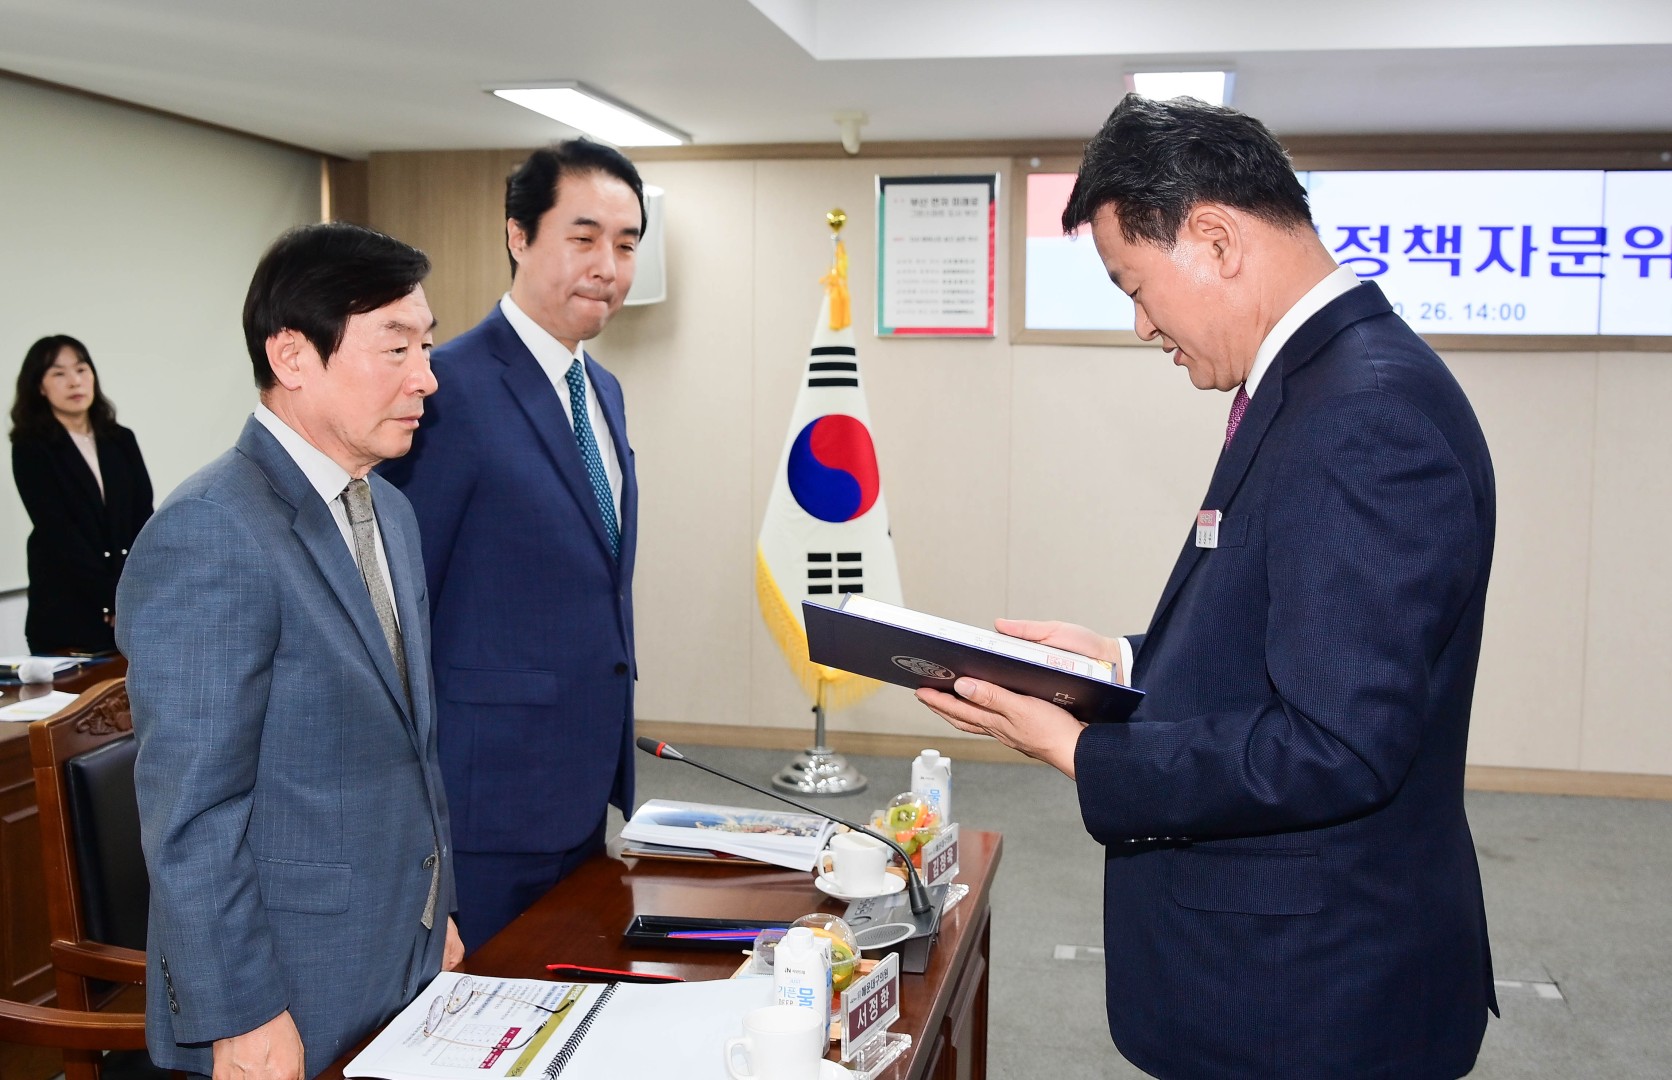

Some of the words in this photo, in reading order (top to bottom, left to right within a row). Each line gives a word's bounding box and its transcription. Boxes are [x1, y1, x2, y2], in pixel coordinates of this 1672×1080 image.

[1314, 225, 1672, 279] 정책자문위
[1420, 302, 1453, 321] 26.
[1463, 303, 1527, 321] 14:00
[796, 987, 816, 1010] 물
[857, 984, 890, 1030] 서정학
